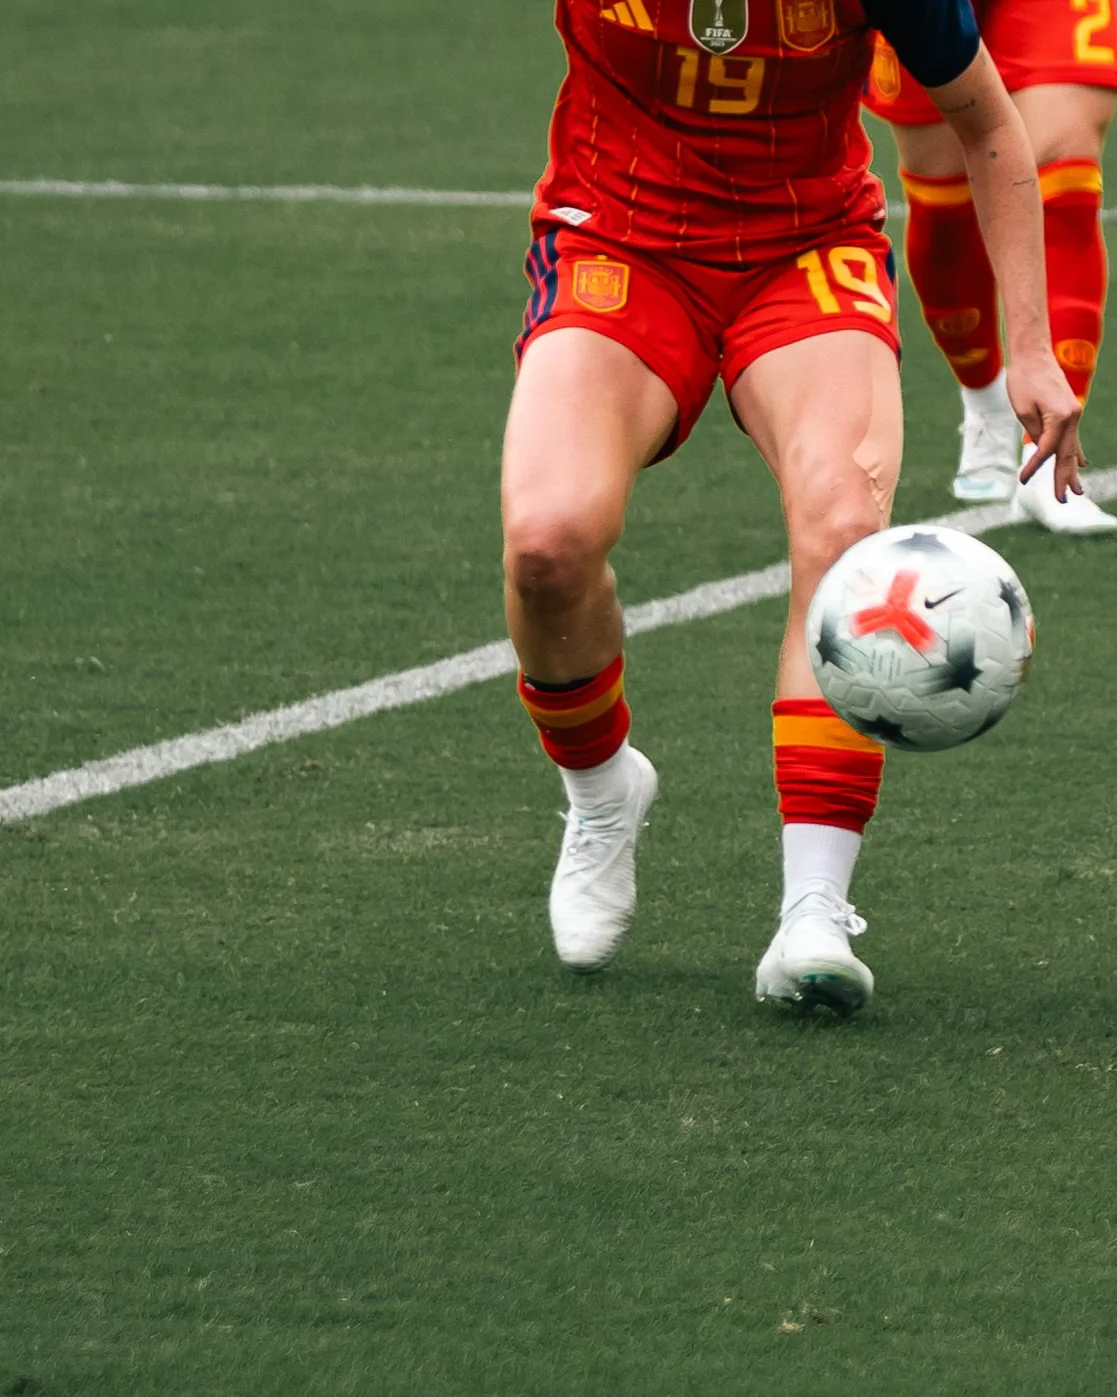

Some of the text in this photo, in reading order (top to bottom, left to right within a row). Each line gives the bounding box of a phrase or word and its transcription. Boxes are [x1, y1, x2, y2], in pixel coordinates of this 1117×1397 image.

[705, 27, 731, 38] FIFA
[675, 46, 765, 115] 19
[796, 246, 892, 324] 19
